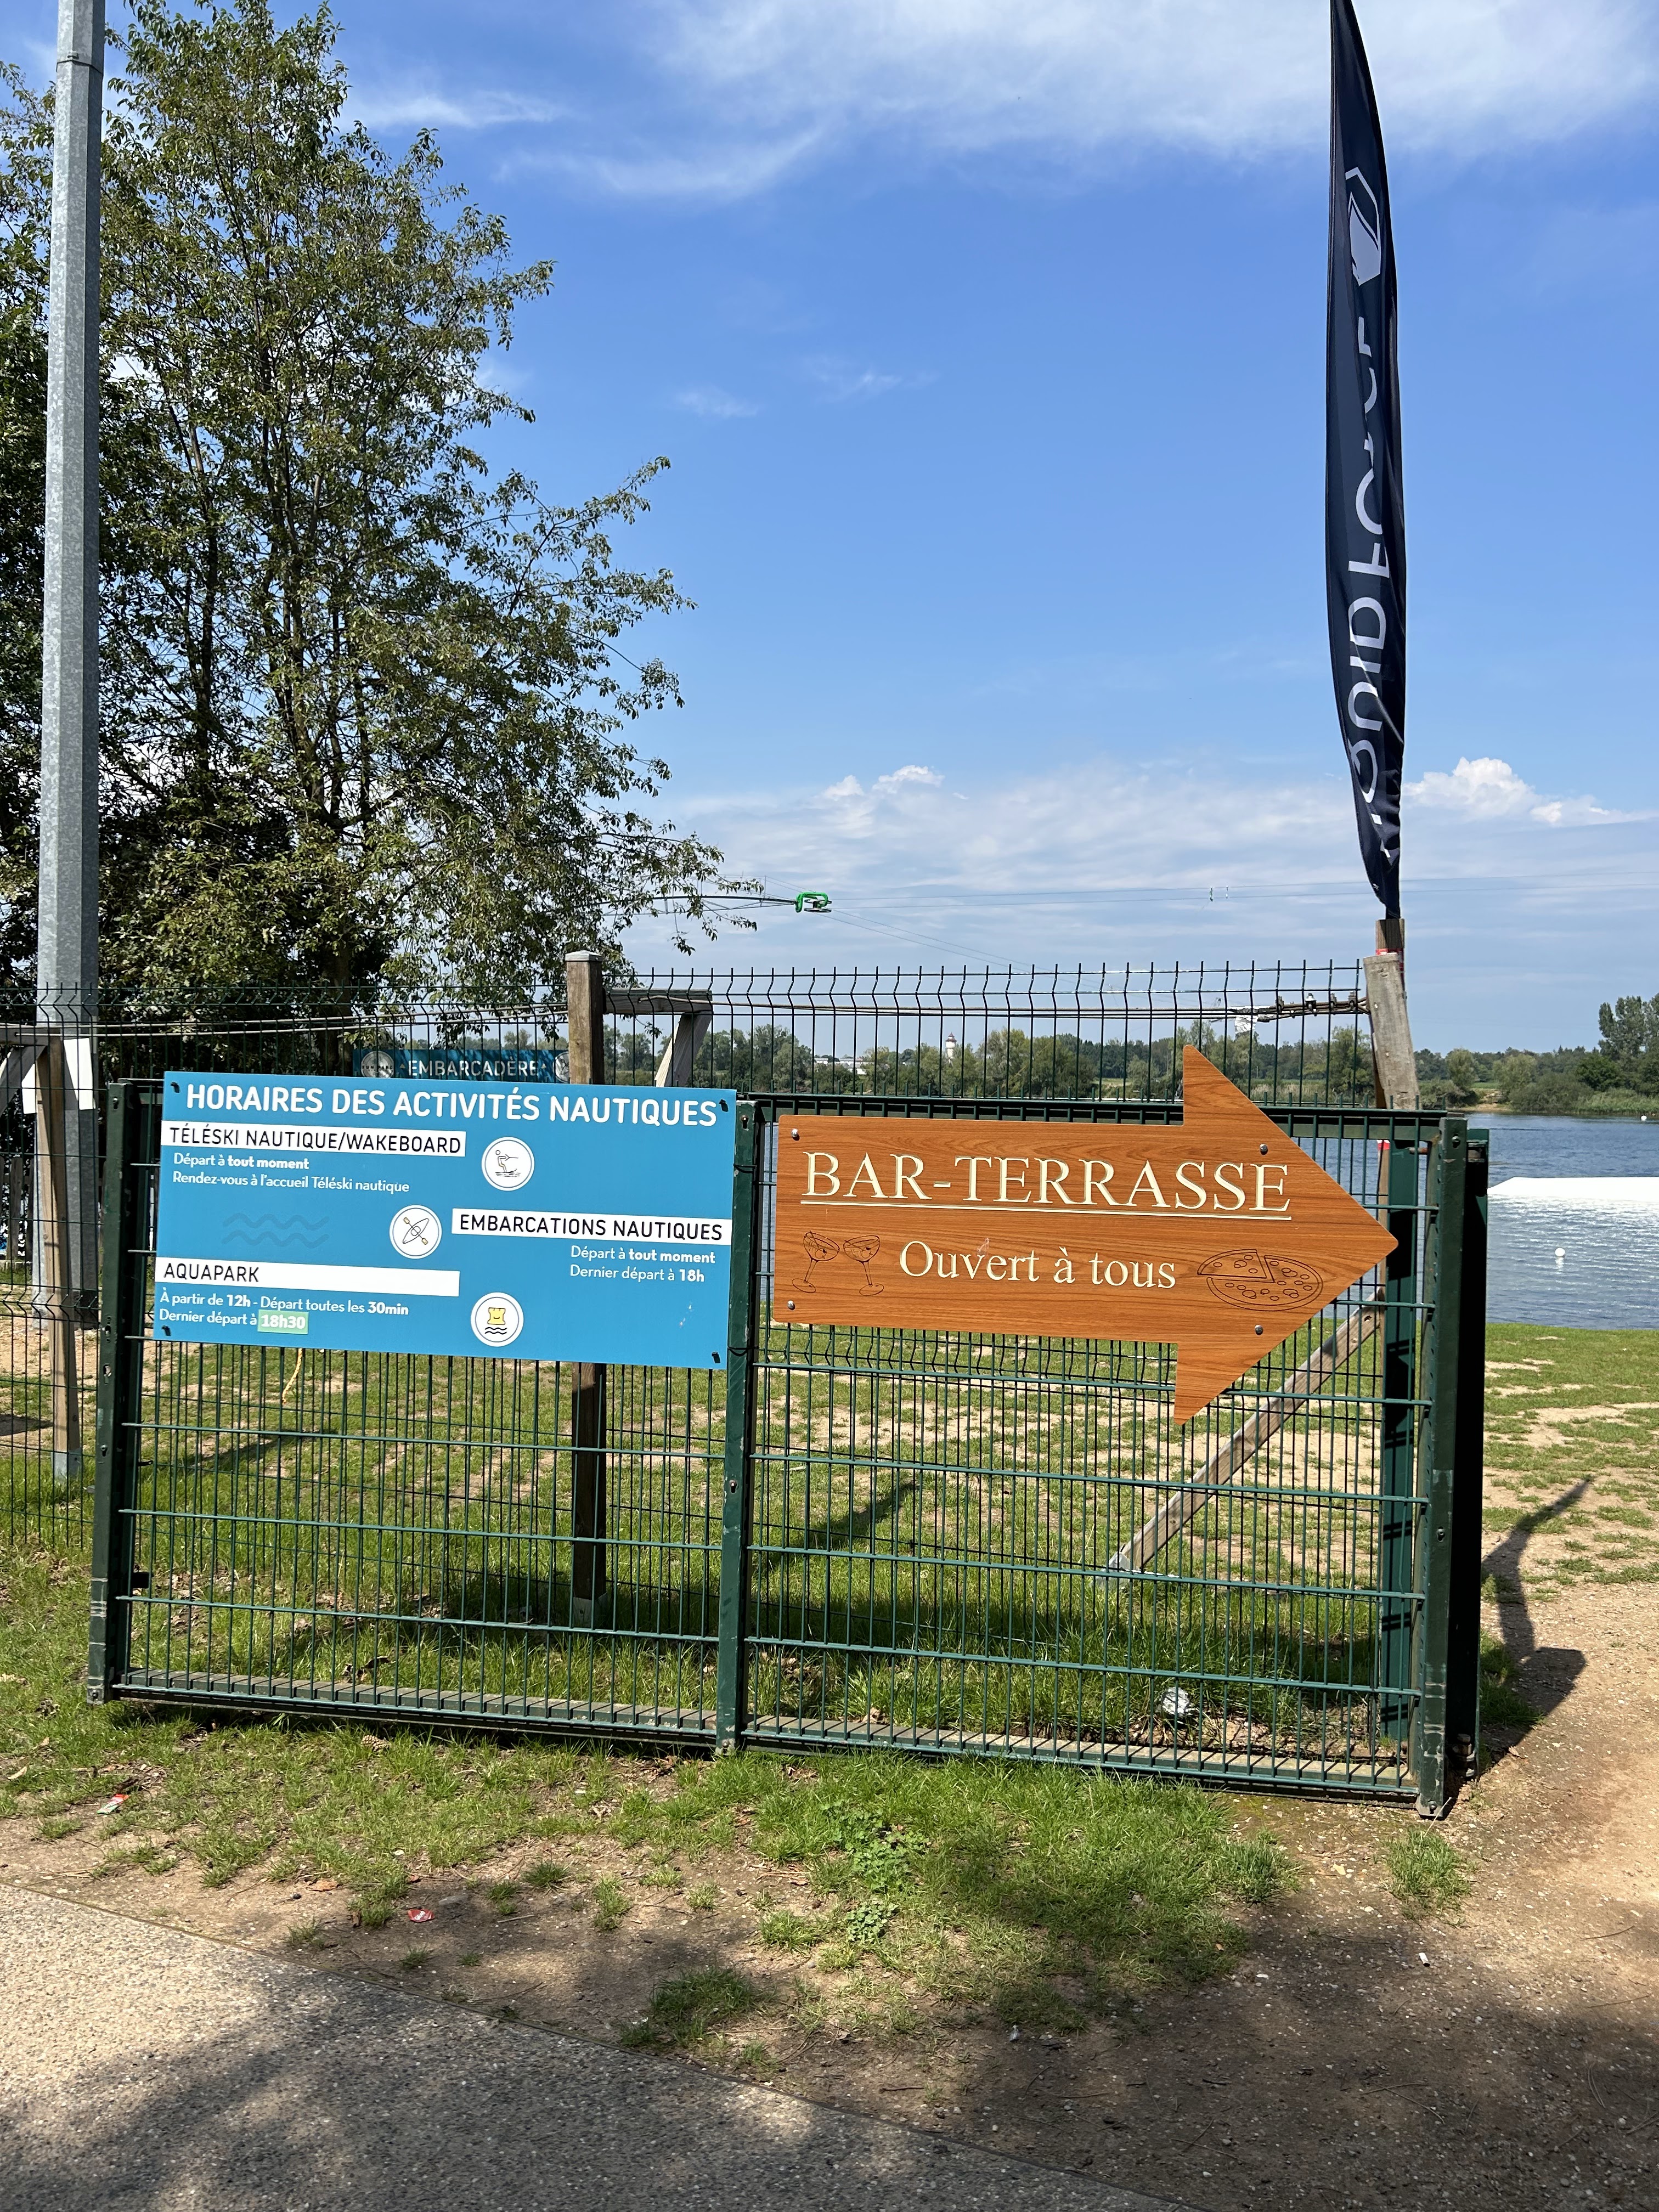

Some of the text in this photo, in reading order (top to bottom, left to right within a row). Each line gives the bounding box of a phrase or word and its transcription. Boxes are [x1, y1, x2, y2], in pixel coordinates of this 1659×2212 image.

[408, 1057, 539, 1077] EMBARCADÈRE
[187, 1084, 716, 1126] HORAIRES DES ACTIVITÉS NAUTIQUES
[170, 1124, 460, 1153] TÉLÉSKI NAUTIQUE/WAKEBOARD
[174, 1153, 309, 1169] Départ à tout moment
[173, 1171, 409, 1194] Rendez-vous à l'accueil Téléski nautique
[802, 1152, 1290, 1211] BAR-TERRASSE
[461, 1215, 721, 1240] EMBARCATIONS NAUTIQUES
[571, 1245, 715, 1263] Départ à tout moment
[900, 1241, 1175, 1288] Ouvert à tous
[165, 1263, 258, 1282] AQUAPARK
[571, 1265, 704, 1282] Dernier départ à 18h
[160, 1287, 169, 1302] À
[172, 1294, 205, 1306] partir
[208, 1294, 223, 1305] de
[227, 1295, 250, 1307] 12h
[261, 1296, 303, 1312] Départ
[306, 1299, 345, 1312] toutes
[348, 1300, 365, 1312] les
[368, 1302, 408, 1314] 30min
[160, 1308, 305, 1329] Dernier départ à 18h30
